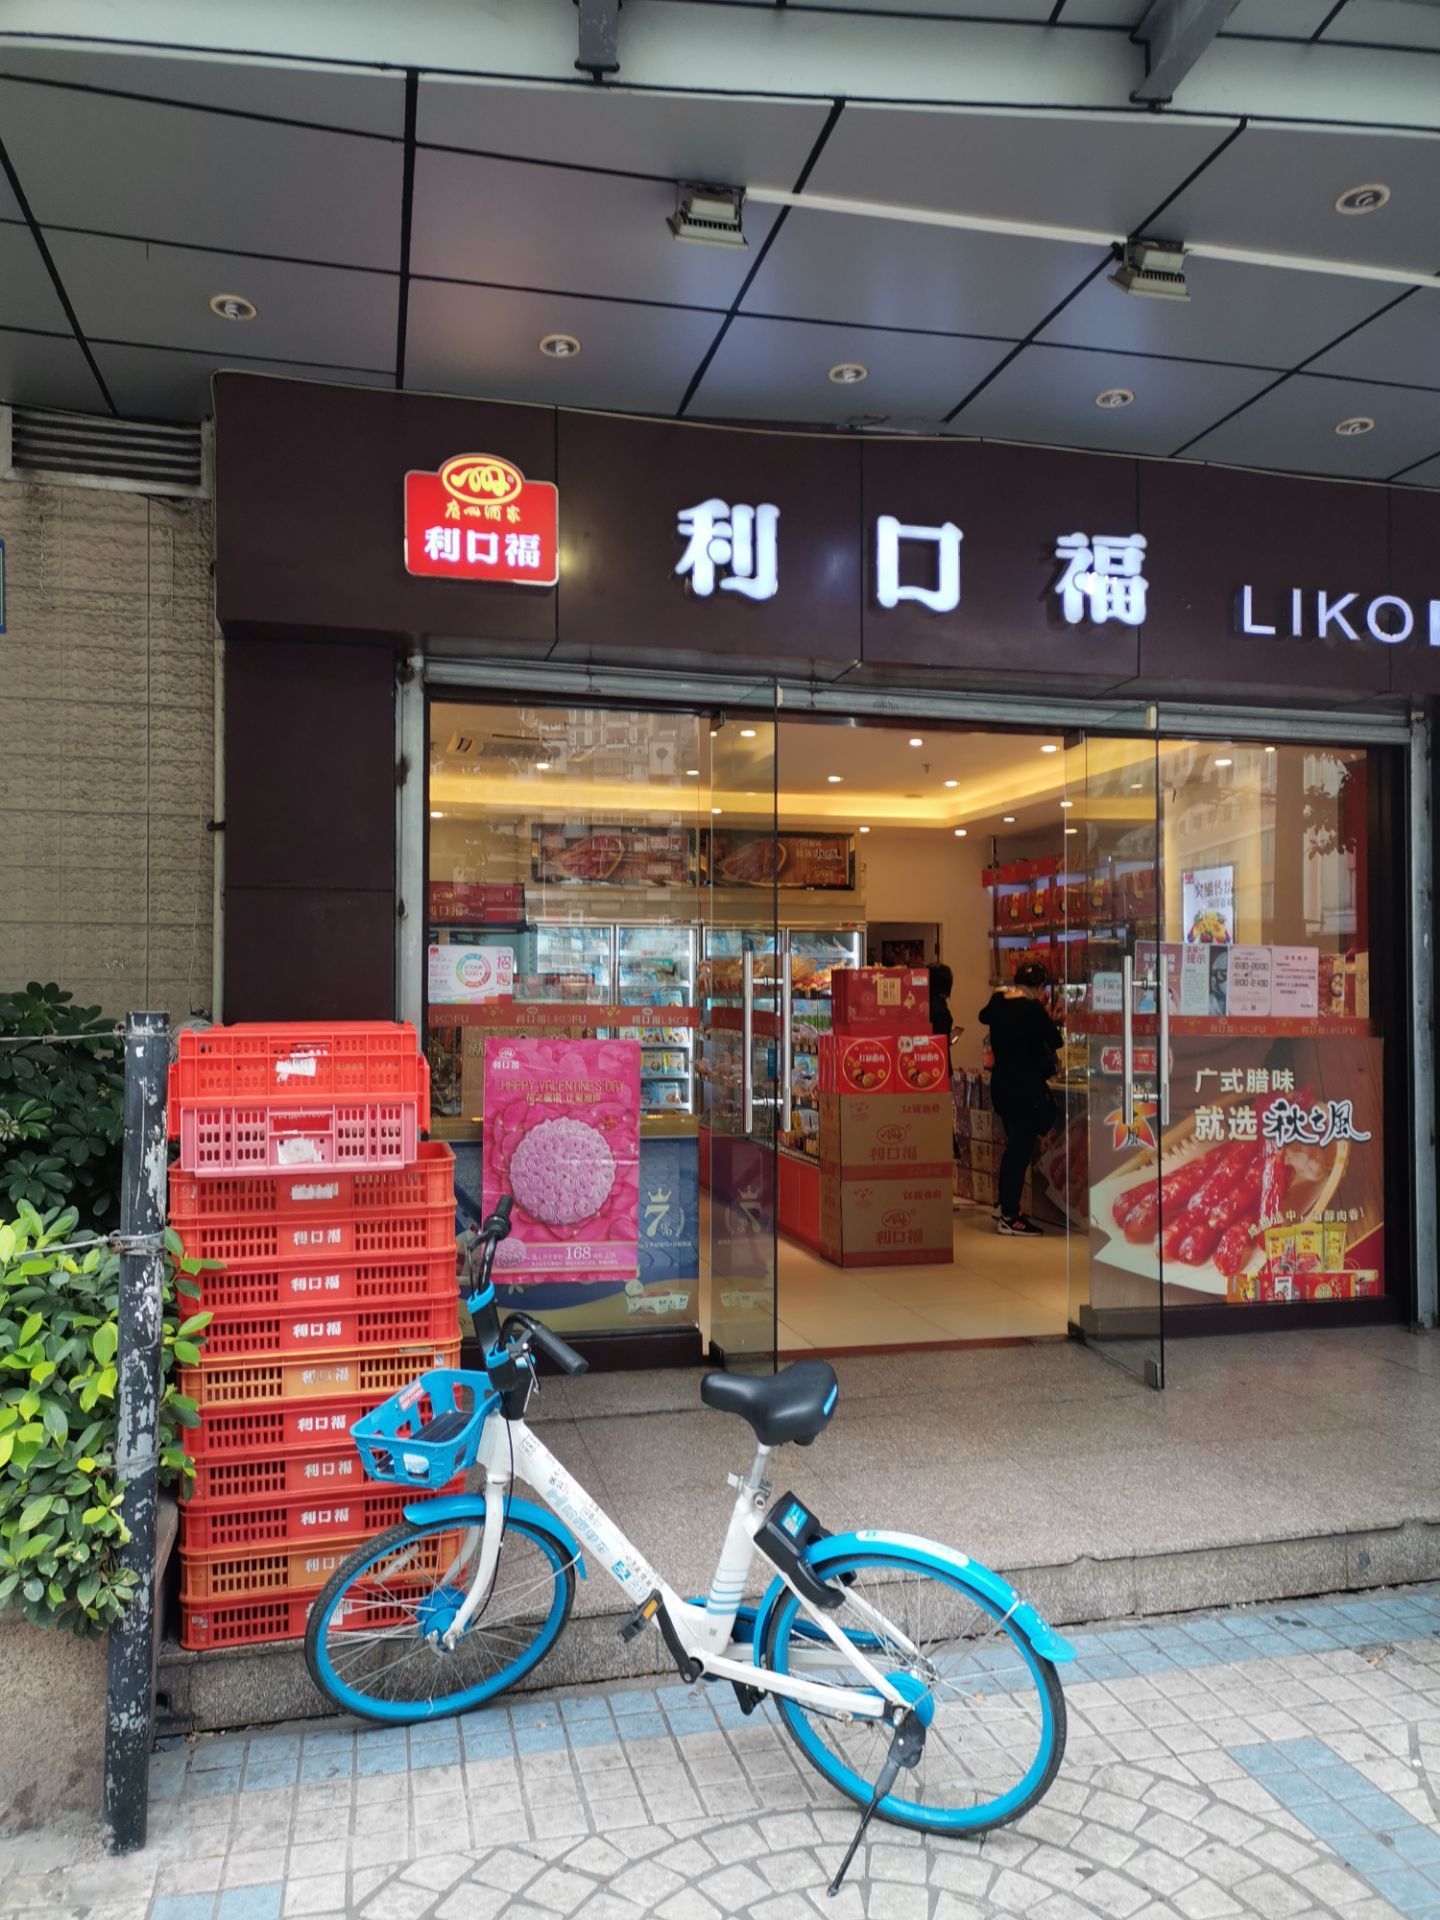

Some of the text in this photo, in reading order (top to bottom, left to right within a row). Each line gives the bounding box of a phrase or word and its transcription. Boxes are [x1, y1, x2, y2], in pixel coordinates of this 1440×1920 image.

[424, 526, 540, 568] 利口福
[675, 498, 1148, 625] 利口福
[1243, 585, 1440, 647] LIKO
[501, 1080, 534, 1091] HAPPY
[605, 1080, 625, 1092] DAY
[1195, 1068, 1295, 1094] 广式腊味
[870, 1146, 917, 1161] 利口福
[293, 1228, 341, 1246] 利口福
[875, 1230, 923, 1245] 利口福
[565, 1247, 592, 1261] 168
[291, 1274, 340, 1292] 利口福
[293, 1321, 341, 1338] 利口福
[298, 1415, 346, 1432] 利口福
[304, 1460, 352, 1478] 利口福
[300, 1507, 349, 1526] 利口福
[305, 1556, 350, 1574] 利口
